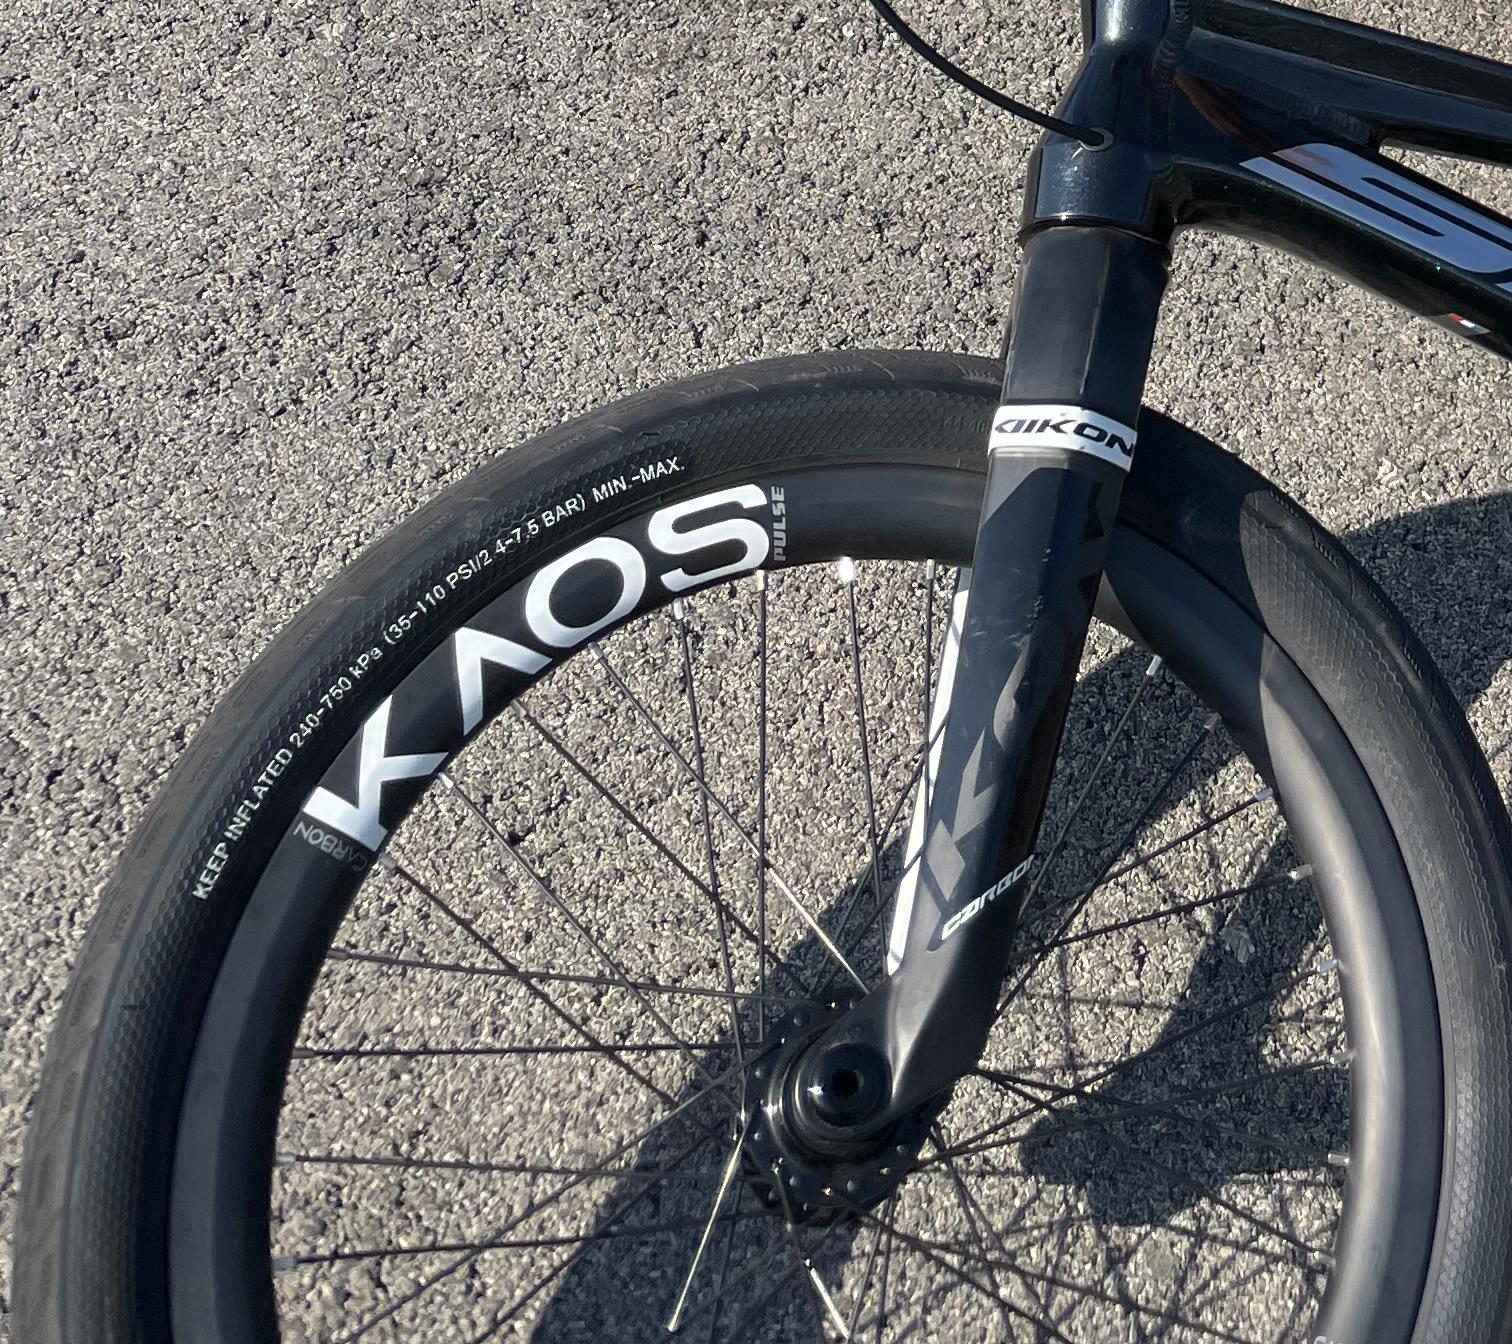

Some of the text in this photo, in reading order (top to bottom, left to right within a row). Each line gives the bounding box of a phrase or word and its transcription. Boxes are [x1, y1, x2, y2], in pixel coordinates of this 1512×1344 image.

[770, 485, 786, 560] PULSE
[192, 835, 239, 902] KEEP
[219, 746, 294, 843] INFLATED
[288, 674, 352, 764] 240-750
[349, 645, 386, 689] kPa
[384, 582, 448, 647] (35-110
[539, 495, 588, 530] BAR)
[591, 455, 686, 503] MIN.-MAX.
[302, 483, 771, 852] KAOS
[292, 821, 370, 874] CARBON
